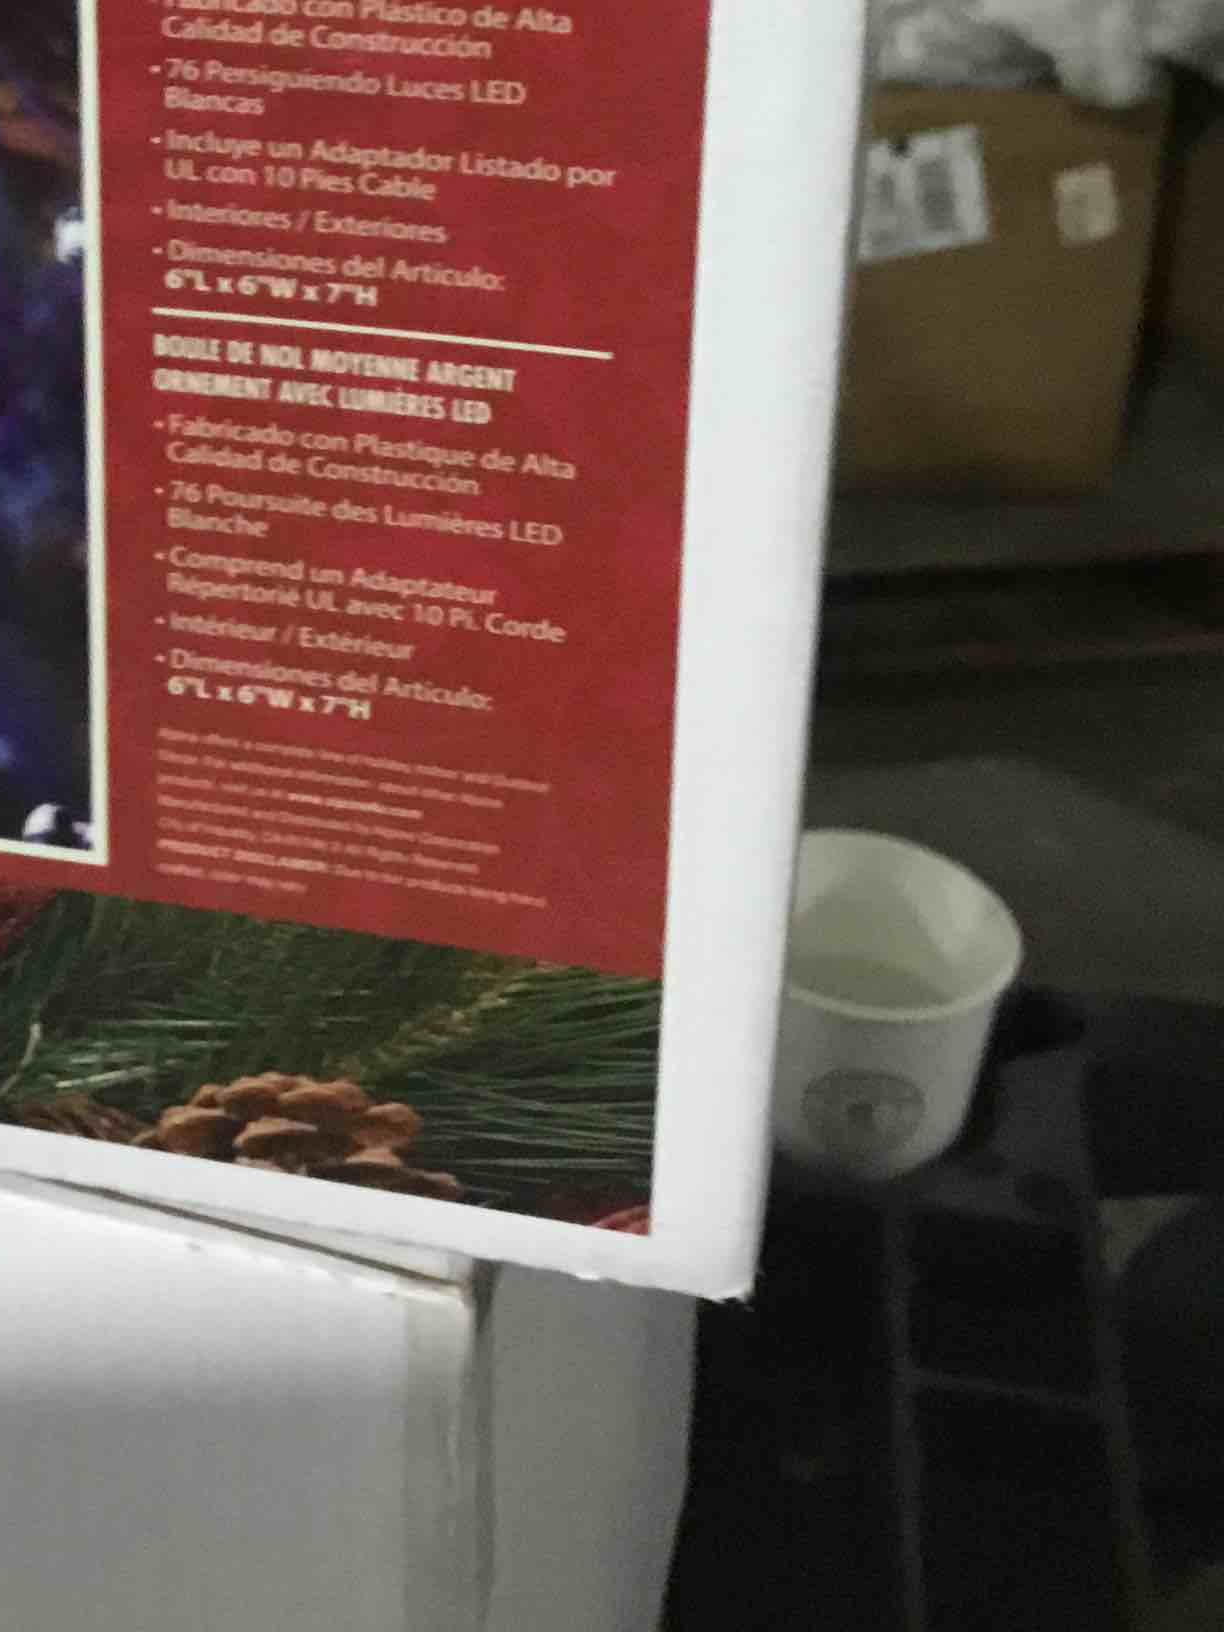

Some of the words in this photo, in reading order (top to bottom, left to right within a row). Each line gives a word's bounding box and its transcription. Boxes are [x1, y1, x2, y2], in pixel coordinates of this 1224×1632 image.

[162, 16, 263, 43] Calidad
[269, 25, 303, 47] de
[472, 6, 508, 29] de
[516, 9, 572, 33] Alta
[165, 87, 264, 114] Blancas
[166, 59, 199, 81] 76
[206, 61, 380, 94] Persiguiendo
[386, 76, 463, 101] Luces
[471, 81, 526, 104] LED
[165, 160, 200, 181] UL
[206, 168, 255, 185] con
[264, 167, 294, 188] 10
[301, 168, 352, 192] Pies
[358, 174, 435, 200] Cable
[166, 130, 261, 160] Incluye
[268, 140, 301, 159] un
[310, 140, 452, 173] Adaptador
[460, 152, 560, 181] Listado
[568, 166, 615, 188] por
[166, 200, 291, 229] Interiores
[314, 211, 447, 243] Exteriores
[168, 240, 335, 275] Dimensiones
[342, 255, 384, 279] del
[217, 276, 232, 293] x
[303, 284, 319, 301] x
[227, 340, 254, 365] DE
[310, 349, 420, 382] MOYENNE
[426, 360, 516, 392] ARGENT
[279, 380, 334, 405] AVEC
[451, 400, 491, 424] LED
[166, 441, 263, 471] Calidad
[269, 452, 301, 474] de
[168, 414, 294, 445] Fabricado
[300, 430, 347, 451] con
[354, 435, 475, 468] Plastique
[481, 450, 515, 471] de
[521, 454, 575, 479] Alta
[168, 508, 268, 537] Blanche
[169, 481, 201, 503] 76
[207, 484, 326, 516] Poursuite
[331, 499, 376, 522] des
[508, 521, 563, 546] LED
[169, 546, 303, 581] Comprend
[310, 564, 343, 585] un
[350, 568, 496, 605] Adaptateur
[306, 590, 337, 613] UL
[346, 598, 404, 621] avec
[413, 603, 443, 625] 10
[485, 613, 566, 643] Corde
[170, 650, 331, 689] Dimensiones
[337, 671, 377, 692] del
[218, 686, 232, 703] x
[300, 696, 315, 713] x
